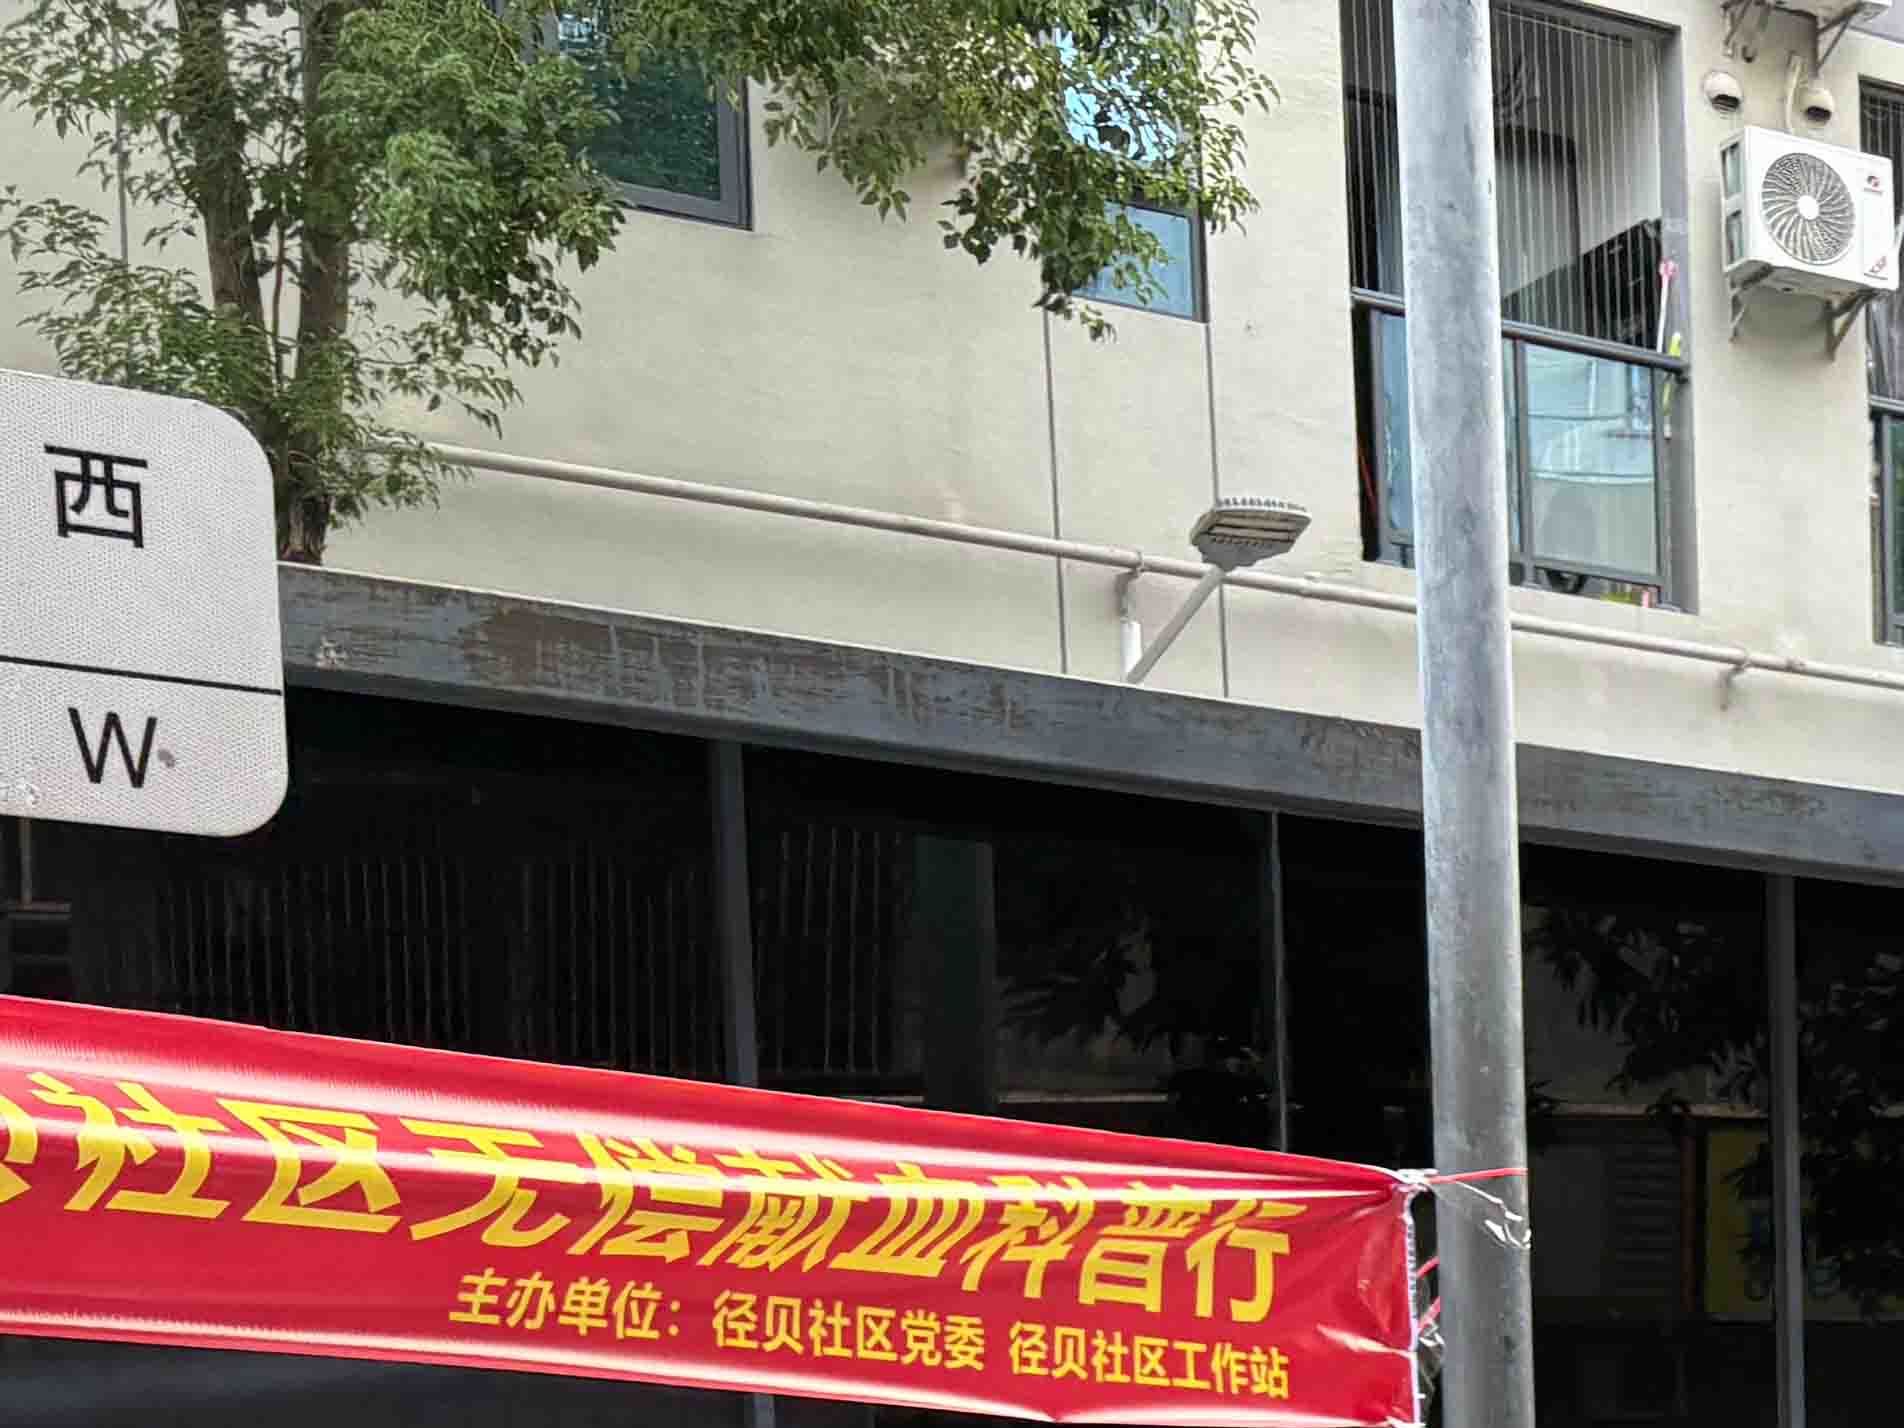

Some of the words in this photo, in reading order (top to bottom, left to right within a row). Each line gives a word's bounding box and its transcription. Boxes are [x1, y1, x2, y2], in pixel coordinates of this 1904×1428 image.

[44, 444, 148, 549] 西
[68, 706, 158, 789] W
[1007, 1320, 1290, 1400] 径贝社区工作站
